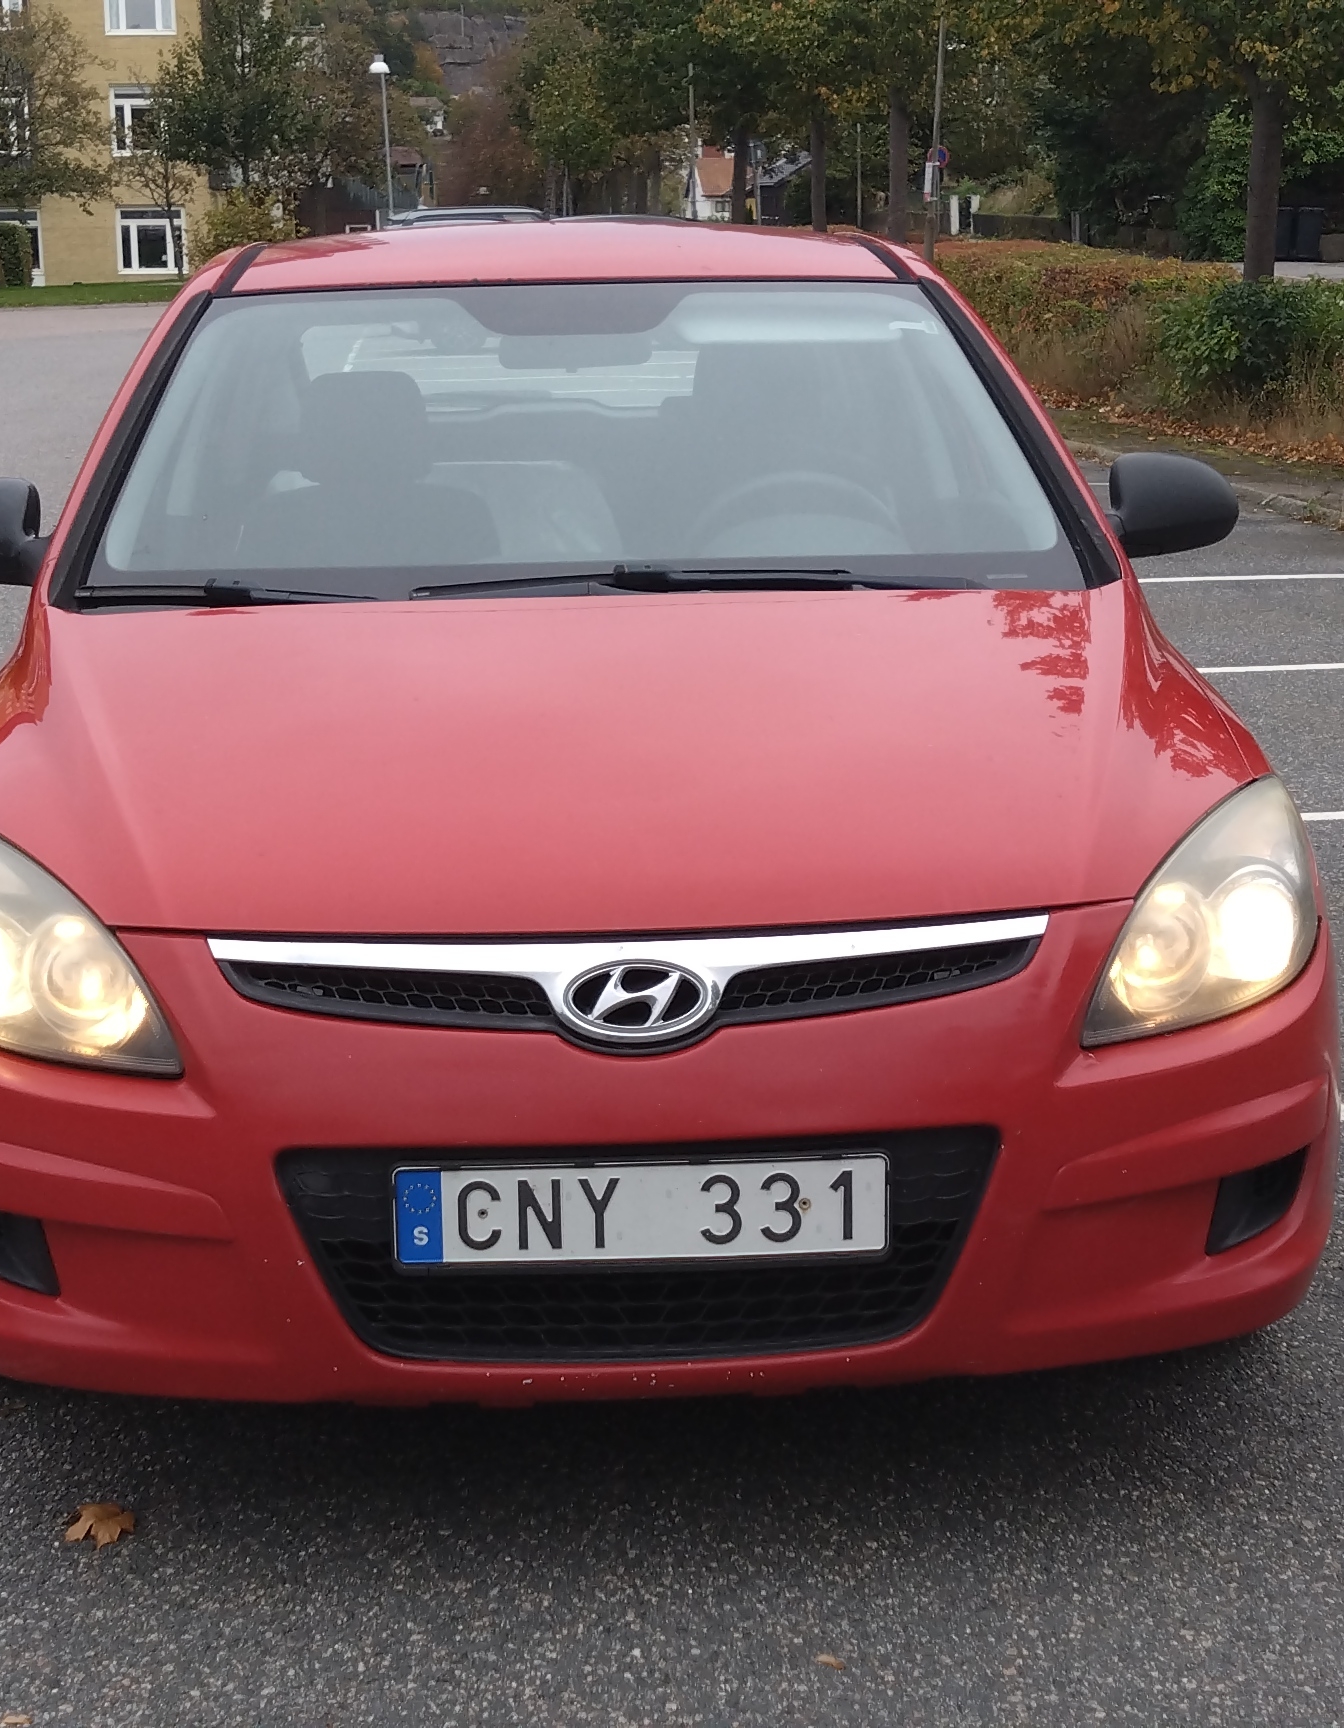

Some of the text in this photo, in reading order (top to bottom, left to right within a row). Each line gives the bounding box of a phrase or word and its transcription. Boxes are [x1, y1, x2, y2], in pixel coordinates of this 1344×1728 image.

[456, 1169, 854, 1251] CNY 331
[413, 1226, 429, 1246] S
